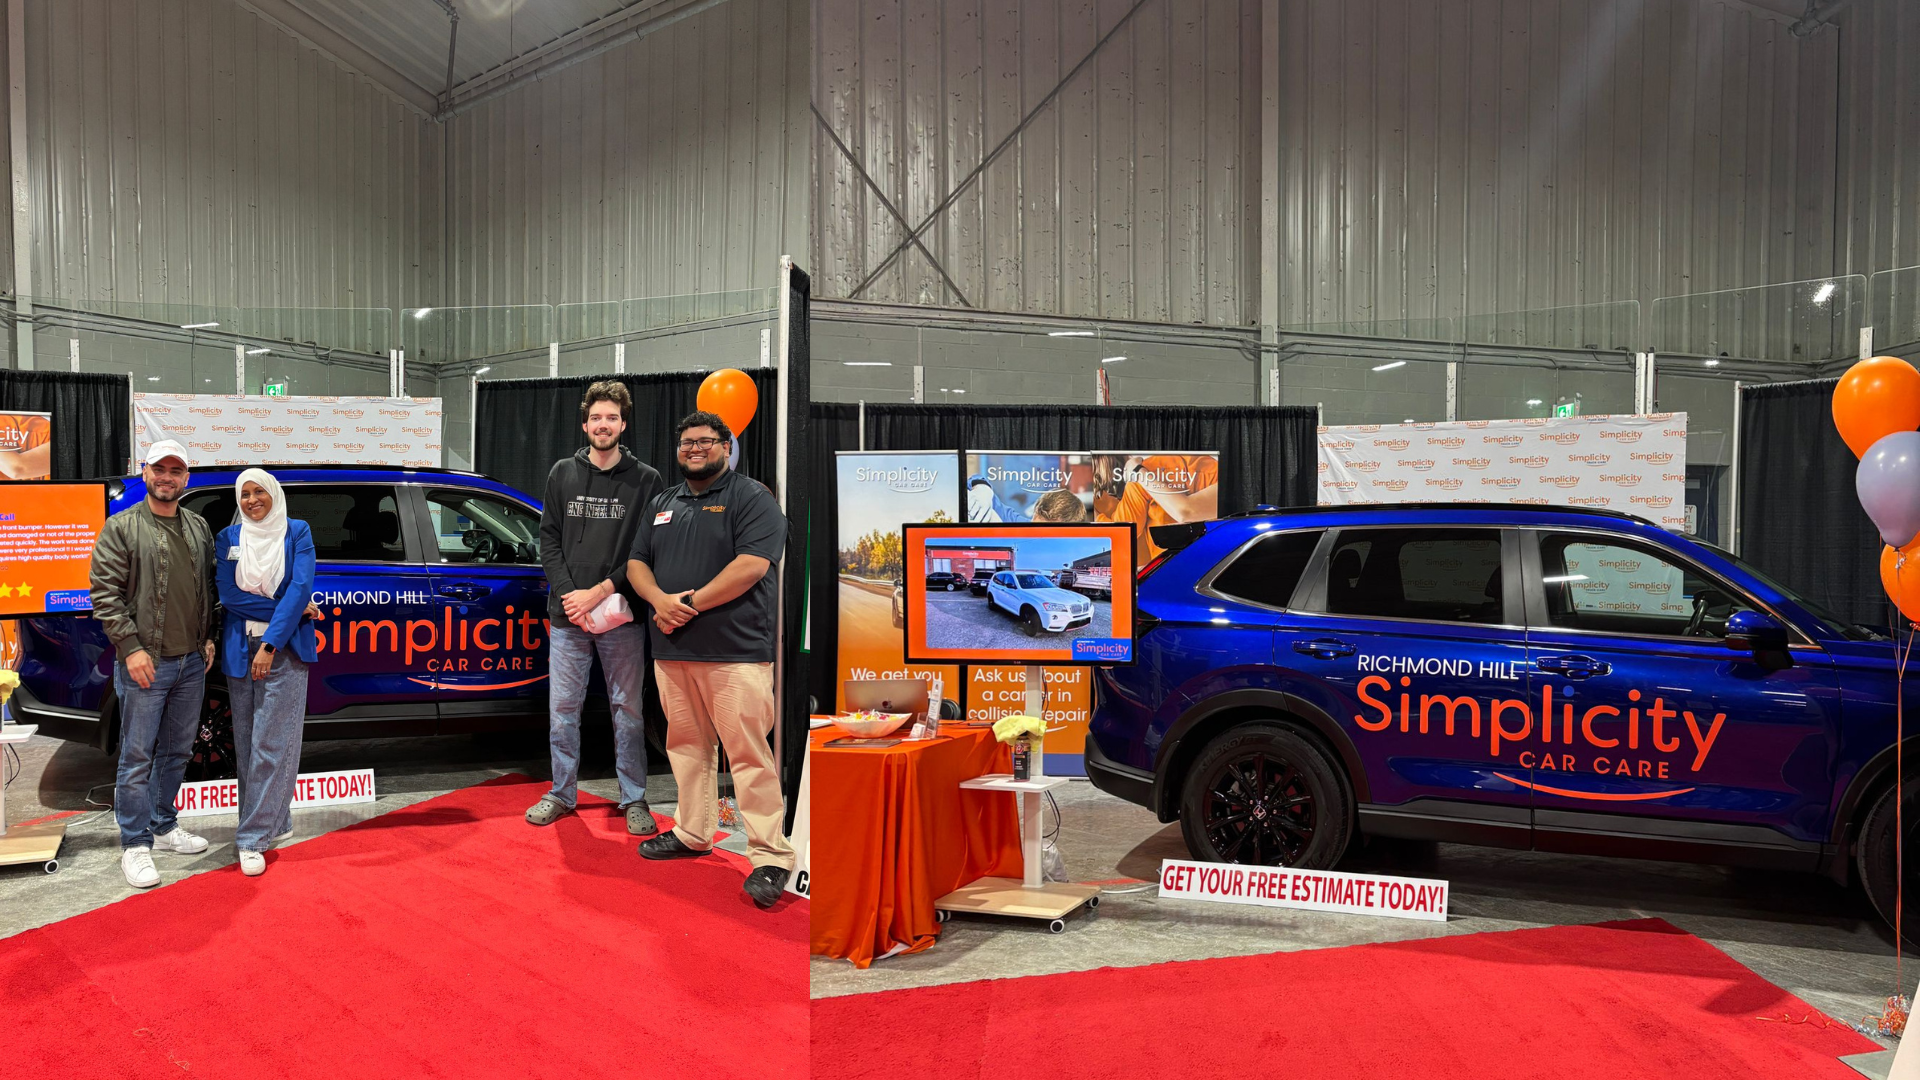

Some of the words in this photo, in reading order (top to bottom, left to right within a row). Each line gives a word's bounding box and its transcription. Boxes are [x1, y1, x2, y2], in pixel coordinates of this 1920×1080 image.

[238, 407, 271, 415] Simplicity
[212, 425, 245, 433] Simplicity
[1483, 435, 1523, 443] Simplicity
[1540, 432, 1580, 441] Simplicity
[1600, 431, 1642, 439] Simplicity
[1374, 439, 1410, 447] Simplicity
[1427, 437, 1465, 445] Simplicity
[1509, 456, 1549, 465] Simplicity
[1568, 453, 1610, 462] Simplicity
[1630, 452, 1673, 461] Simplicity
[1398, 459, 1435, 467] Simplicity
[1452, 458, 1491, 466] Simplicity
[856, 466, 938, 485] Simplicity
[987, 466, 1073, 486] Simplicity
[1112, 467, 1197, 487] Simplicity
[1540, 475, 1580, 484] Simplicity
[1599, 474, 1642, 482] Simplicity
[1425, 478, 1463, 486] Simplicity
[1481, 477, 1521, 486] Simplicity
[1568, 496, 1610, 505] Simplicity
[1630, 495, 1673, 504] Simplicity
[1599, 560, 1641, 569] Simplicity
[1629, 582, 1671, 590] Simplicity
[50, 594, 91, 606] Simplic
[311, 591, 391, 605] CHMOND
[396, 591, 427, 604] HILL
[1599, 602, 1641, 611] Simplicity
[1076, 643, 1129, 655] Simplicity
[427, 657, 469, 672] CAR
[481, 657, 533, 671] CARE
[1357, 654, 1473, 677] RICHMOND
[1479, 661, 1520, 681] HILL
[851, 668, 877, 681] We
[974, 669, 1003, 682] Ask
[1008, 671, 1026, 683] us
[1044, 669, 1081, 683] bout
[982, 690, 993, 702] a
[999, 690, 1053, 702] carr
[1058, 688, 1072, 702] in
[968, 707, 1027, 720] collisio
[1354, 676, 1727, 772] Simplicity
[1519, 751, 1576, 772] CAR
[1594, 757, 1669, 779] CARE
[201, 784, 238, 809] FREE
[317, 774, 372, 800] TODAY!
[1163, 865, 1196, 892] GET
[1199, 867, 1244, 896] YOUR
[1247, 871, 1287, 900] FREE
[1291, 875, 1374, 907] ESTIMATE
[1379, 881, 1444, 914] TODAY!
